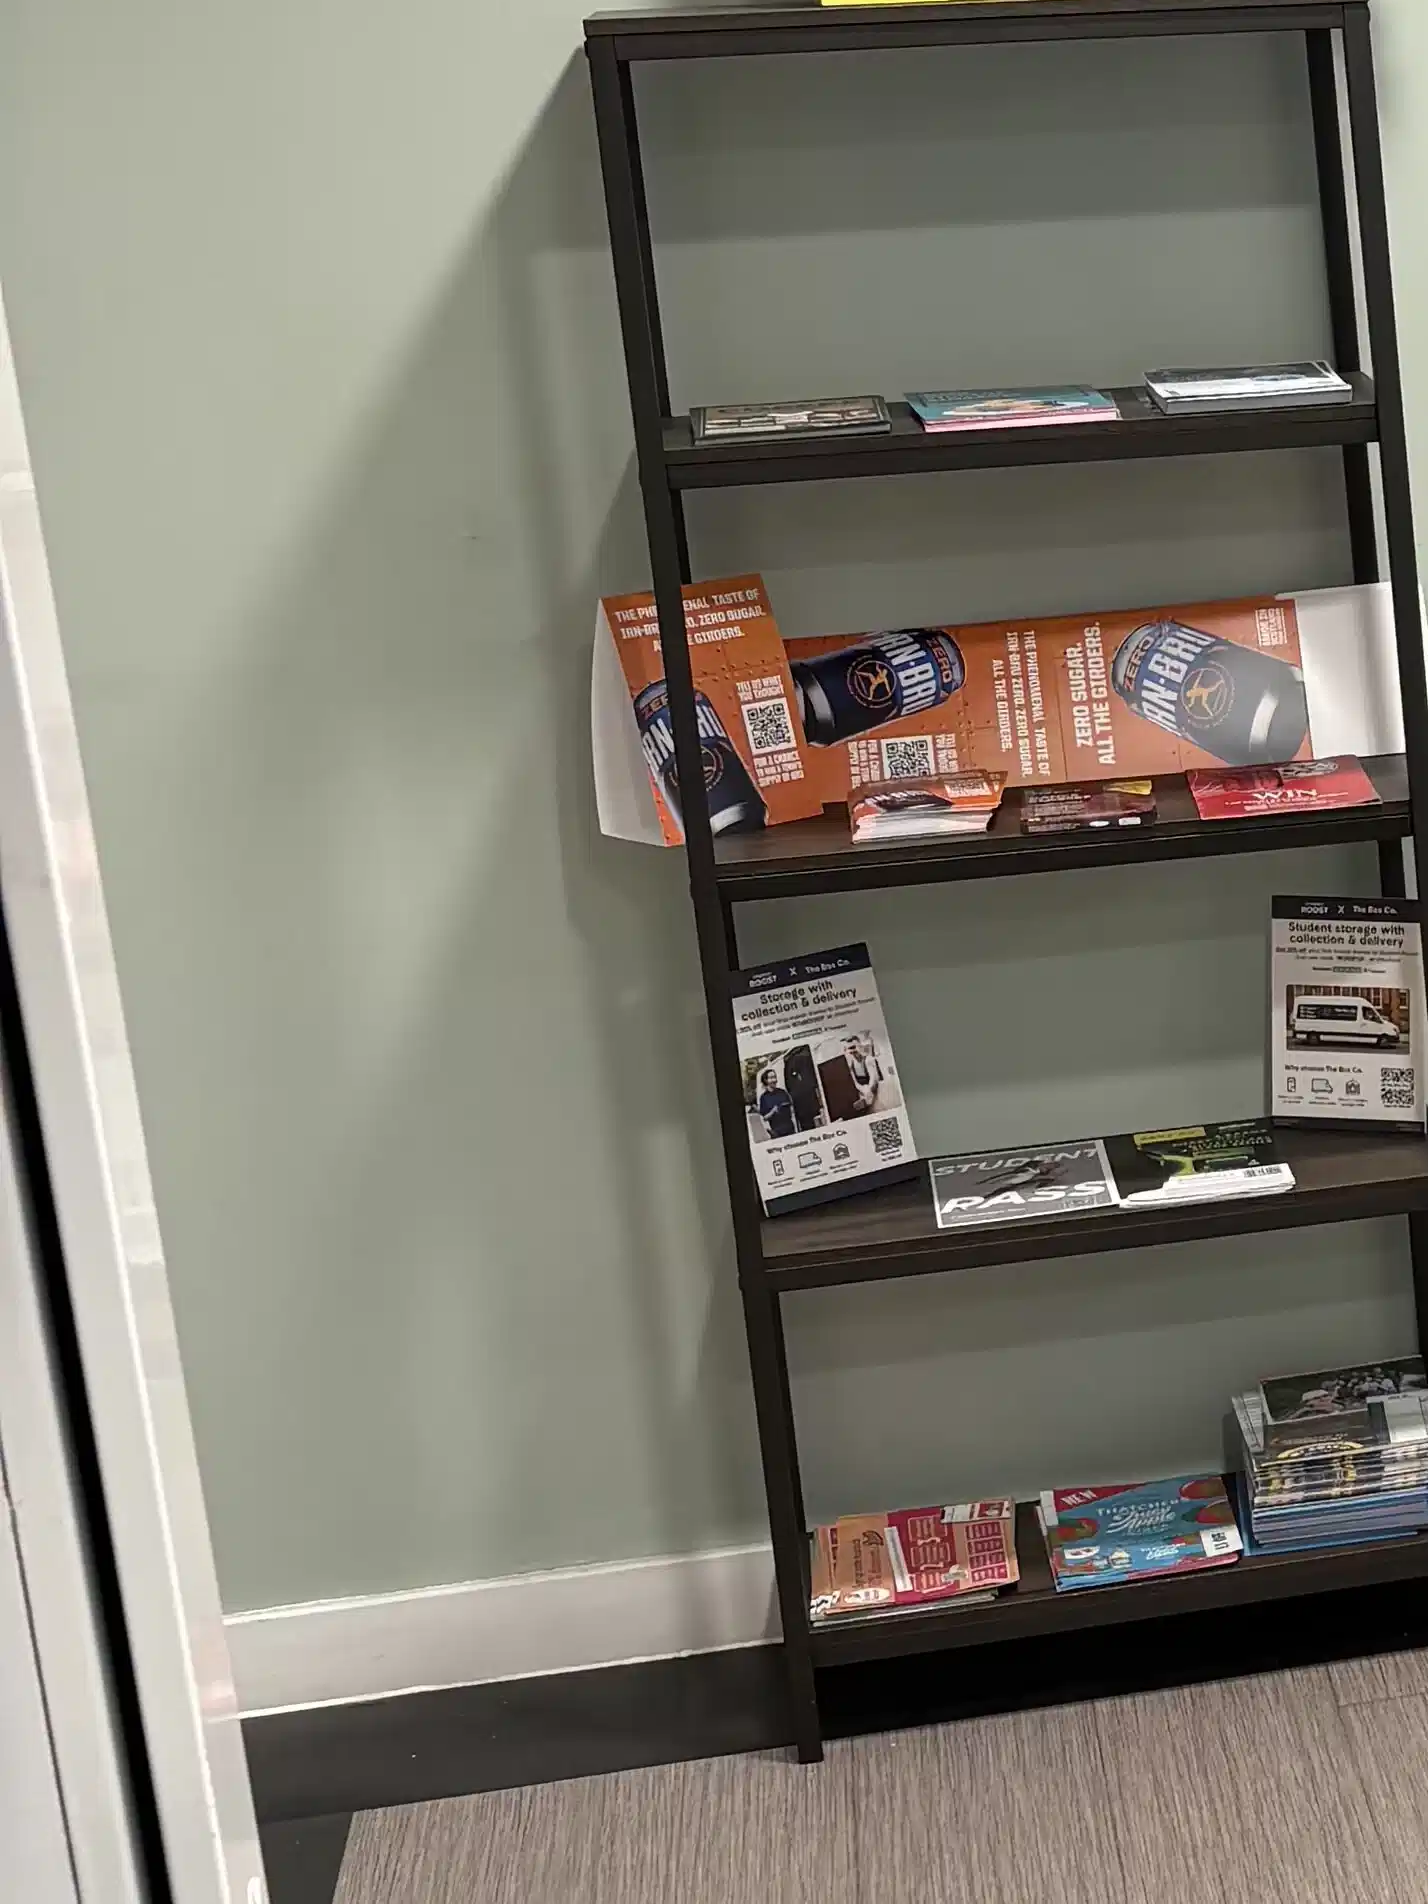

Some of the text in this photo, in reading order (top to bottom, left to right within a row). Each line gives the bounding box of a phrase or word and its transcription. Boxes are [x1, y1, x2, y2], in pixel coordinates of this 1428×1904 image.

[614, 609, 638, 624] THE
[712, 591, 744, 607] TASTE
[745, 587, 761, 602] OF
[698, 611, 727, 627] ZERO
[727, 604, 767, 622] SUGAR.
[692, 626, 745, 646] GIRDERS.
[992, 659, 1005, 678] ALL
[994, 678, 1007, 700] THE
[1022, 629, 1036, 652] THE
[1034, 726, 1049, 757] TASTE
[1065, 642, 1093, 748] ZERO SUGAR.
[1084, 621, 1116, 765] ALL THE GIRDERS.
[1288, 921, 1405, 937] Student storage with
[1289, 934, 1345, 945] collection
[1359, 935, 1404, 949] delivery
[741, 1000, 799, 1022] collection
[812, 987, 858, 1006] delivery
[760, 980, 833, 1005] Storage with
[933, 1148, 1098, 1177] STUDENT
